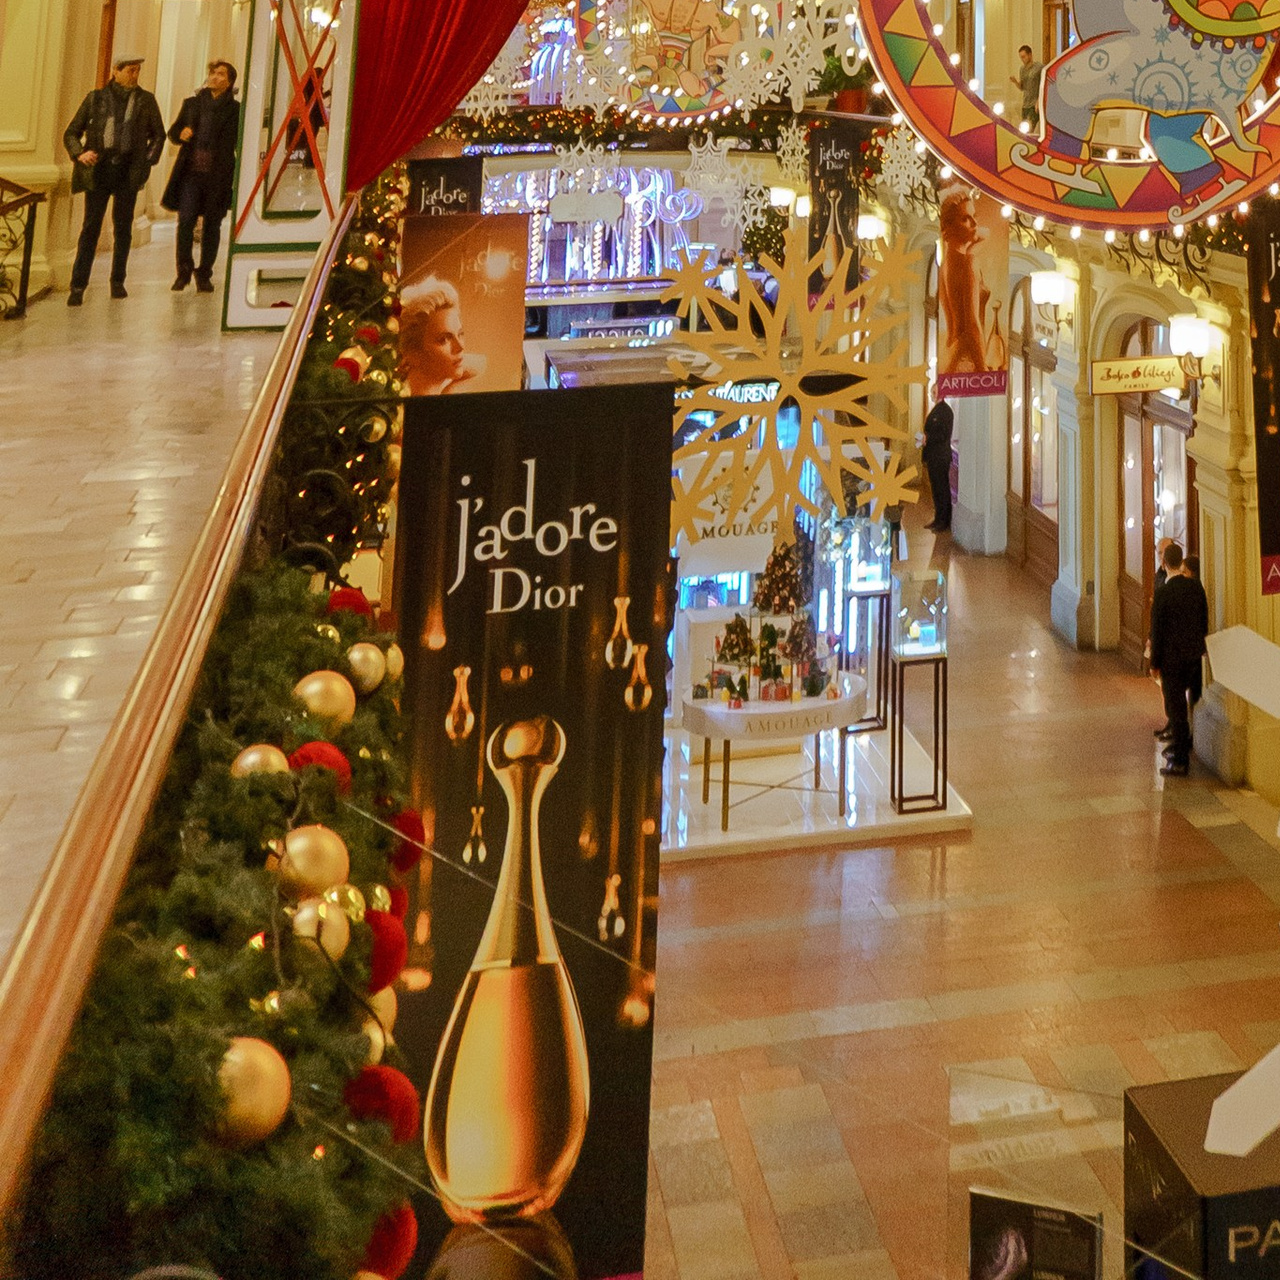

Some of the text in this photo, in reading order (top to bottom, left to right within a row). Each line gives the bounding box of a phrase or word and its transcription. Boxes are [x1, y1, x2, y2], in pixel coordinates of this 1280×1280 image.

[420, 177, 467, 213] j'adore
[941, 375, 1005, 390] ARTICOLI
[447, 458, 618, 596] j'adore
[701, 521, 779, 540] MOUAGE
[486, 567, 584, 615] Dior
